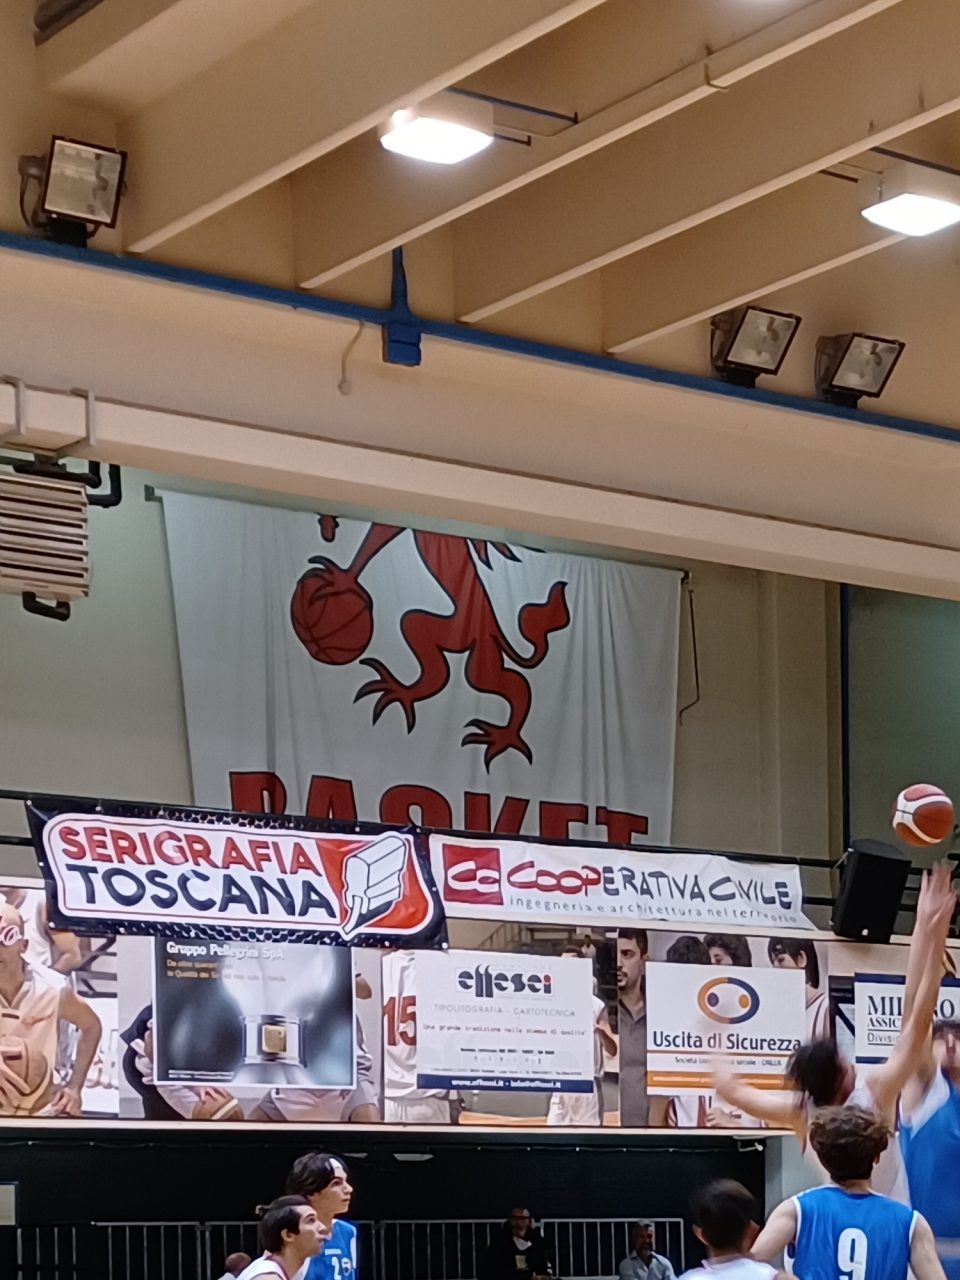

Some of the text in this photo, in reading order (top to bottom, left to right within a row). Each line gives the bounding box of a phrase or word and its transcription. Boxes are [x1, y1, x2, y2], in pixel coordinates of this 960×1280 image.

[58, 826, 323, 876] SERIGRAFIA
[65, 863, 337, 919] TOSCANA
[510, 895, 592, 912] ingegneria
[610, 903, 701, 918] architettura
[166, 941, 207, 957] Gruppo
[458, 963, 552, 998] effesei
[383, 996, 417, 1046] 15
[653, 1031, 801, 1051] Uscita di Sicurezza
